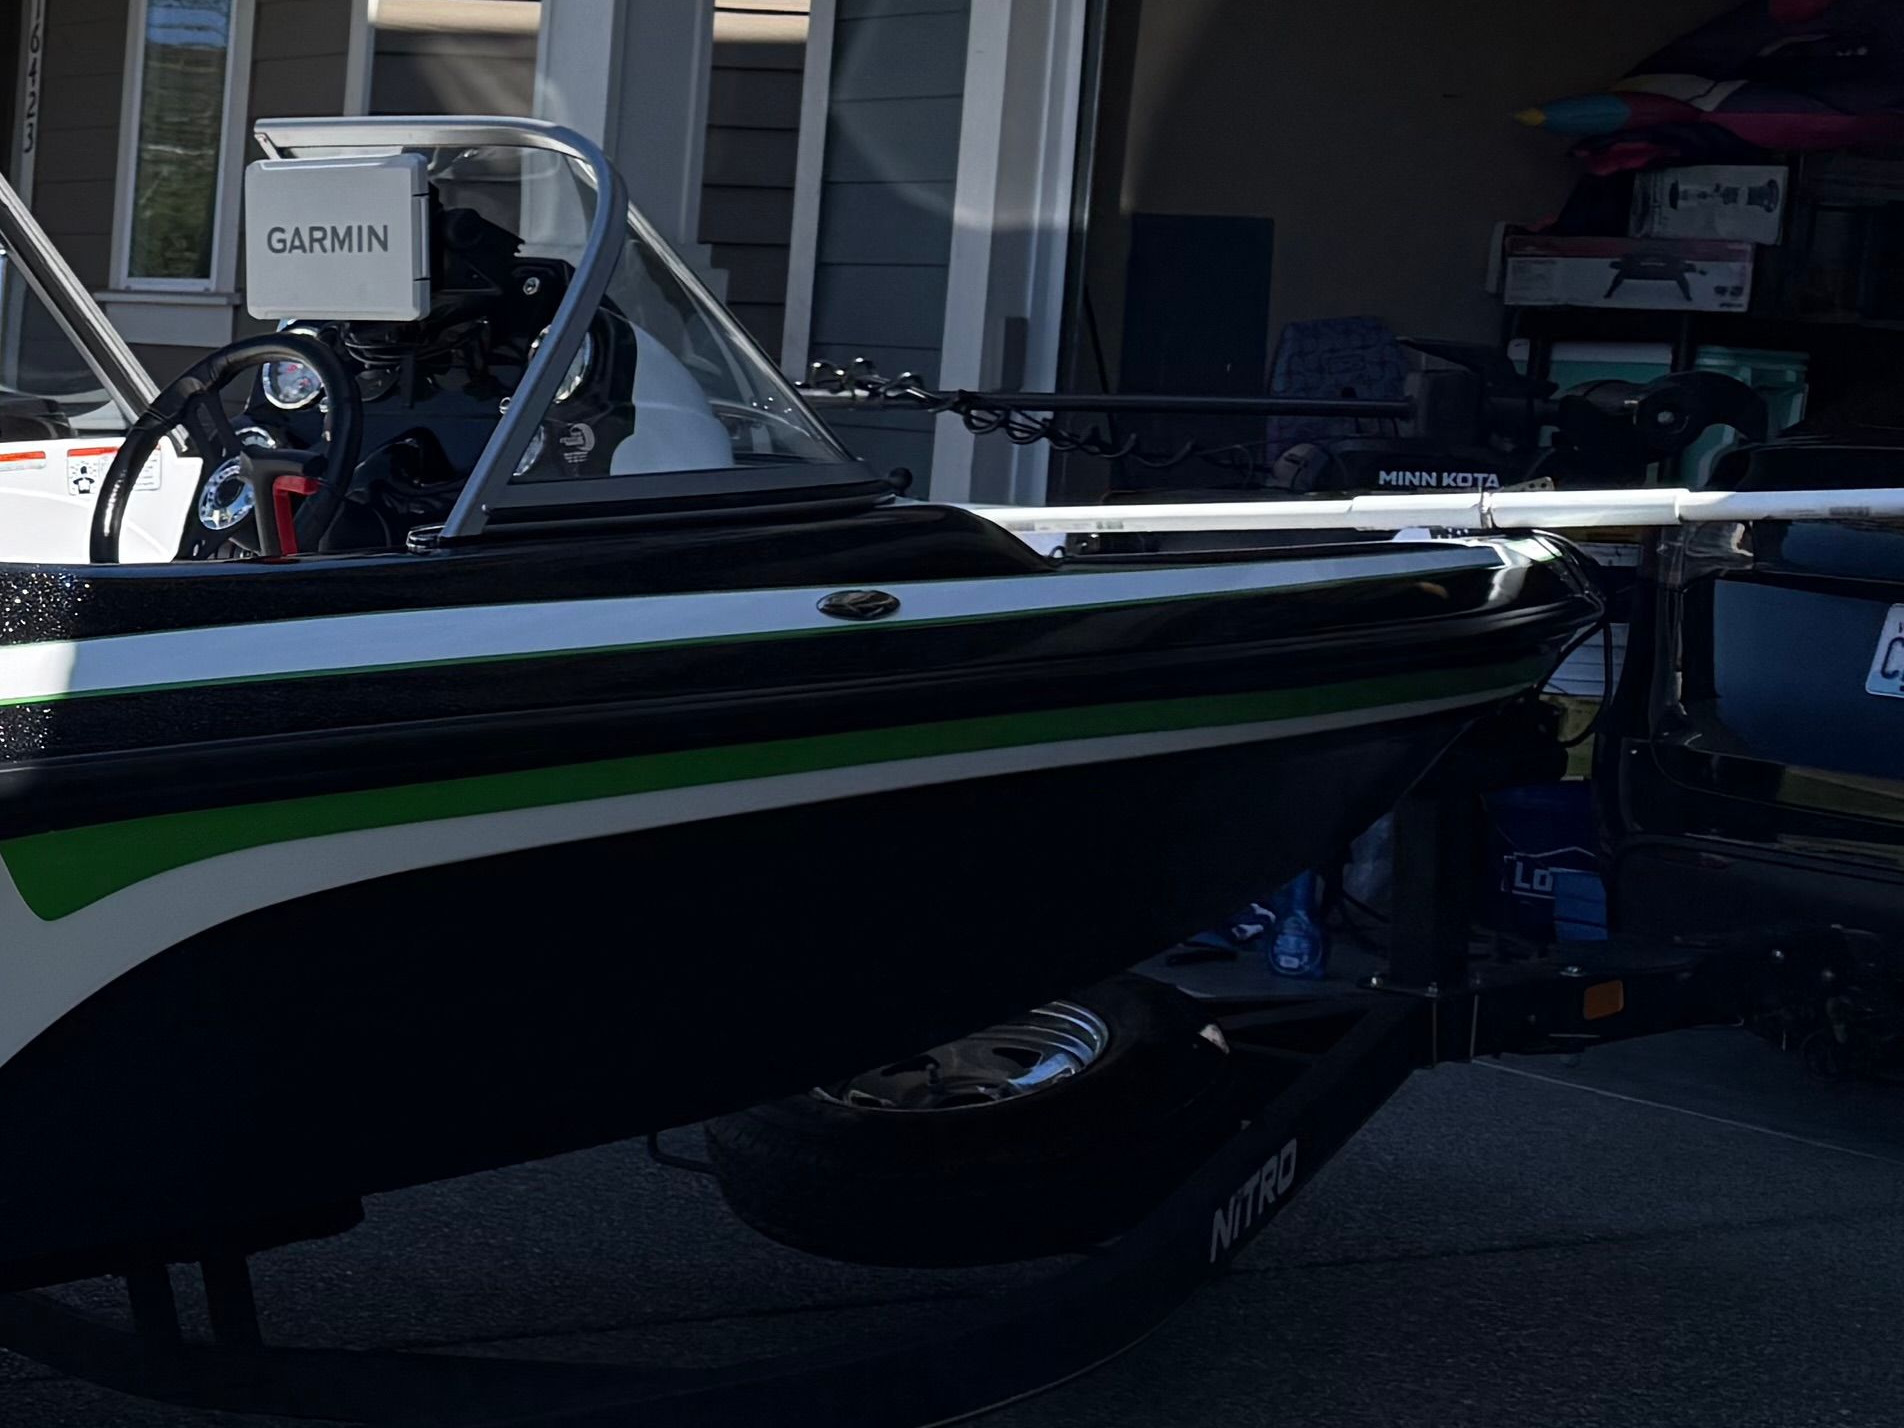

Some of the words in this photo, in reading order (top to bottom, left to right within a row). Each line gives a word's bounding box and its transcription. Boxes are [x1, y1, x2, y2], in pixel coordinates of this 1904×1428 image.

[266, 224, 390, 254] GARMIN
[1378, 470, 1438, 488] MINN
[1442, 471, 1501, 489] KOTA
[1208, 1136, 1298, 1265] NITRO
